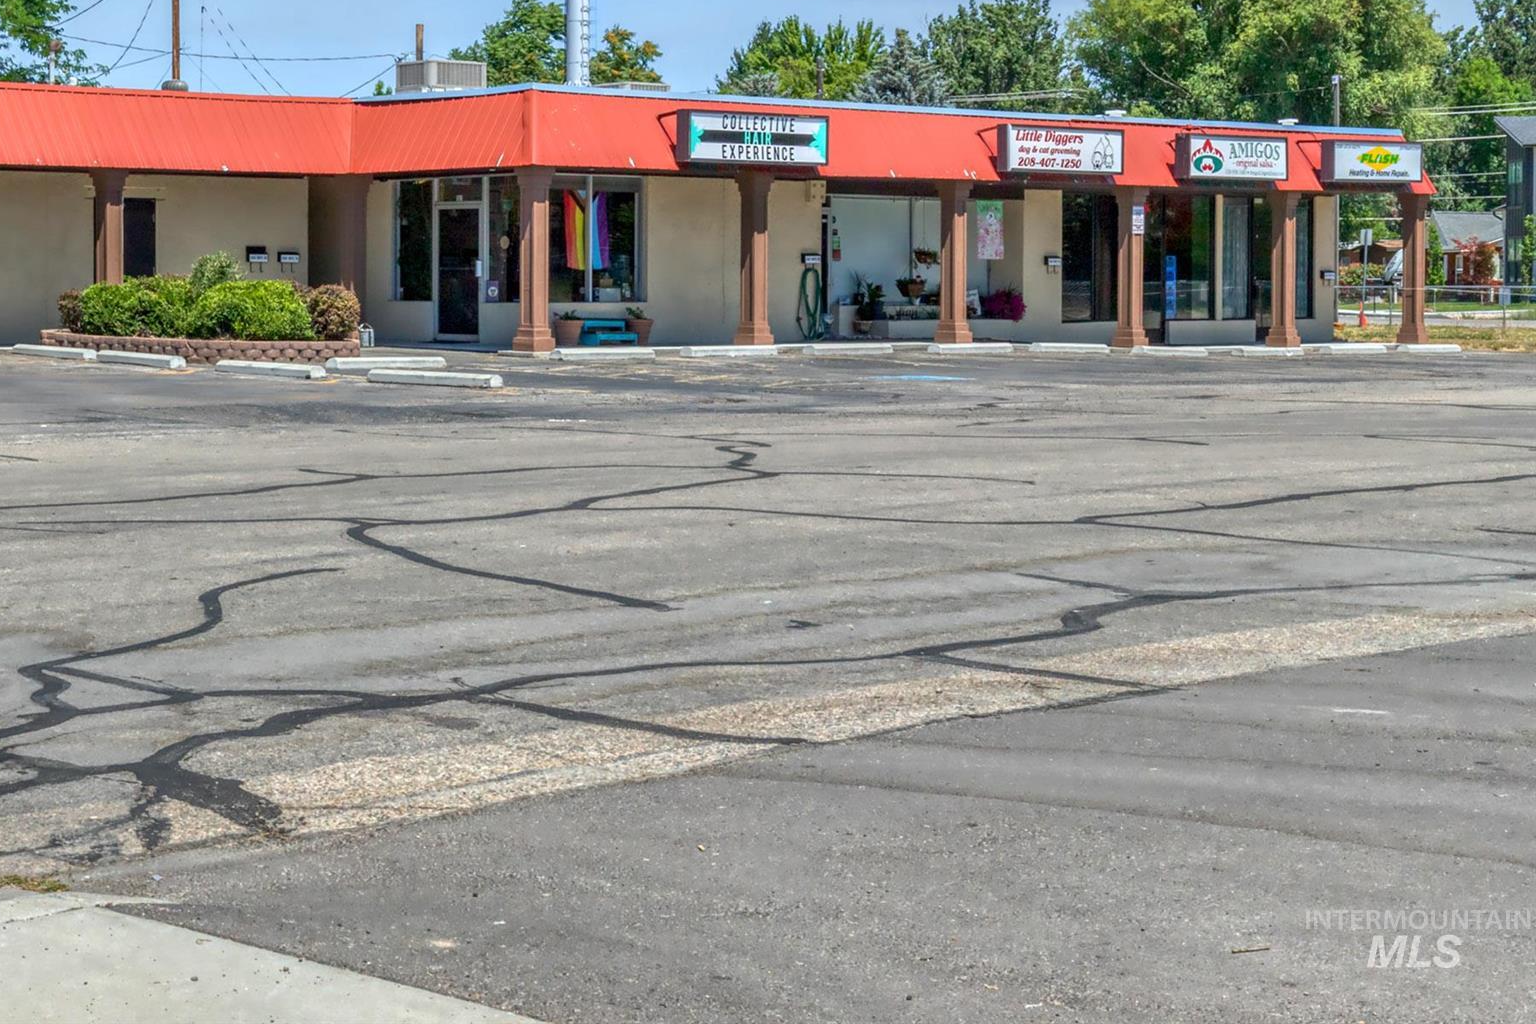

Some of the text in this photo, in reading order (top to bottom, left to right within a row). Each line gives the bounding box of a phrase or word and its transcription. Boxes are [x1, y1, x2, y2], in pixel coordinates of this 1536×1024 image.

[721, 114, 796, 133] COLLECTIVE
[744, 131, 772, 145] HAIR
[1015, 129, 1084, 146] Little Diggers
[721, 144, 796, 161] EXPERIENCE
[1018, 145, 1031, 154] dog
[1032, 145, 1038, 153] &
[1050, 147, 1081, 156] grooming
[1228, 142, 1281, 161] AMIGOS
[1017, 156, 1082, 169] 208-407-1250
[1360, 153, 1400, 164] FLASH
